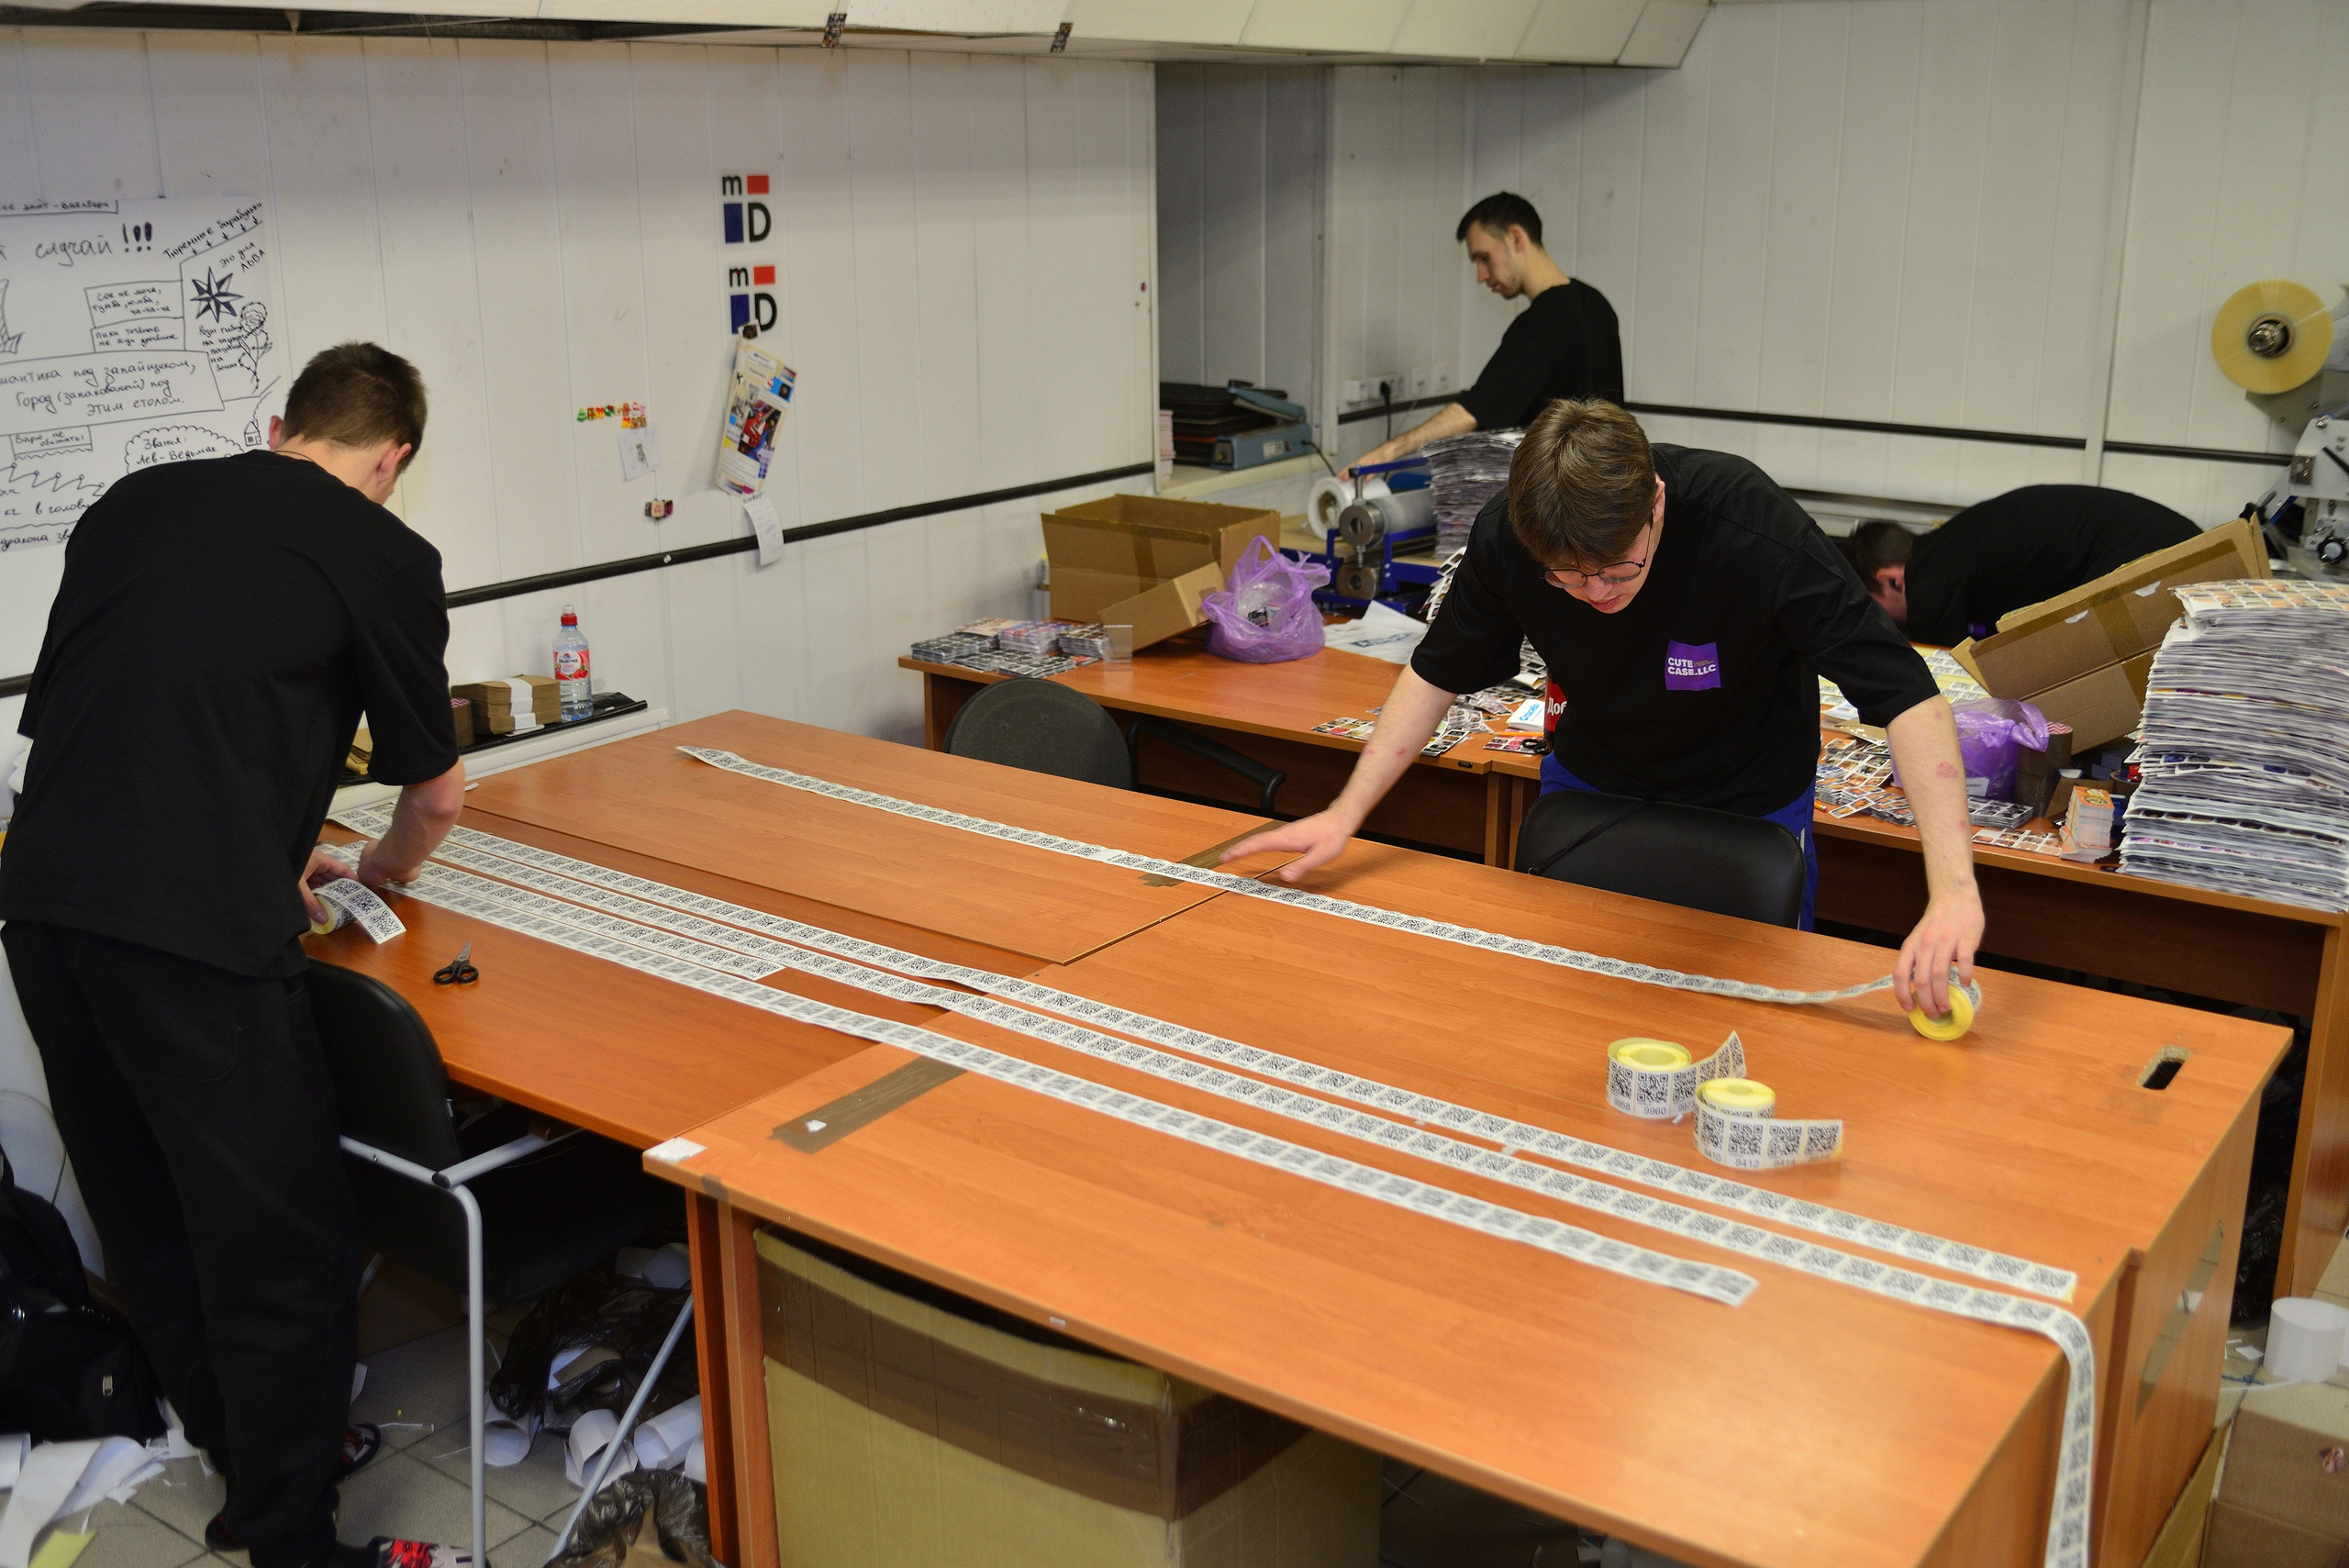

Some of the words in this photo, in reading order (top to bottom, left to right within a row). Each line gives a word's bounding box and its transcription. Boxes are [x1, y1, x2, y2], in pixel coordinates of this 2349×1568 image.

[73, 367, 96, 387] под
[150, 379, 172, 396] под
[1667, 657, 1694, 668] CUTE
[1667, 663, 1717, 676] CASE.LLC
[1643, 1106, 1667, 1116] 9960
[1734, 1157, 1760, 1169] 8412
